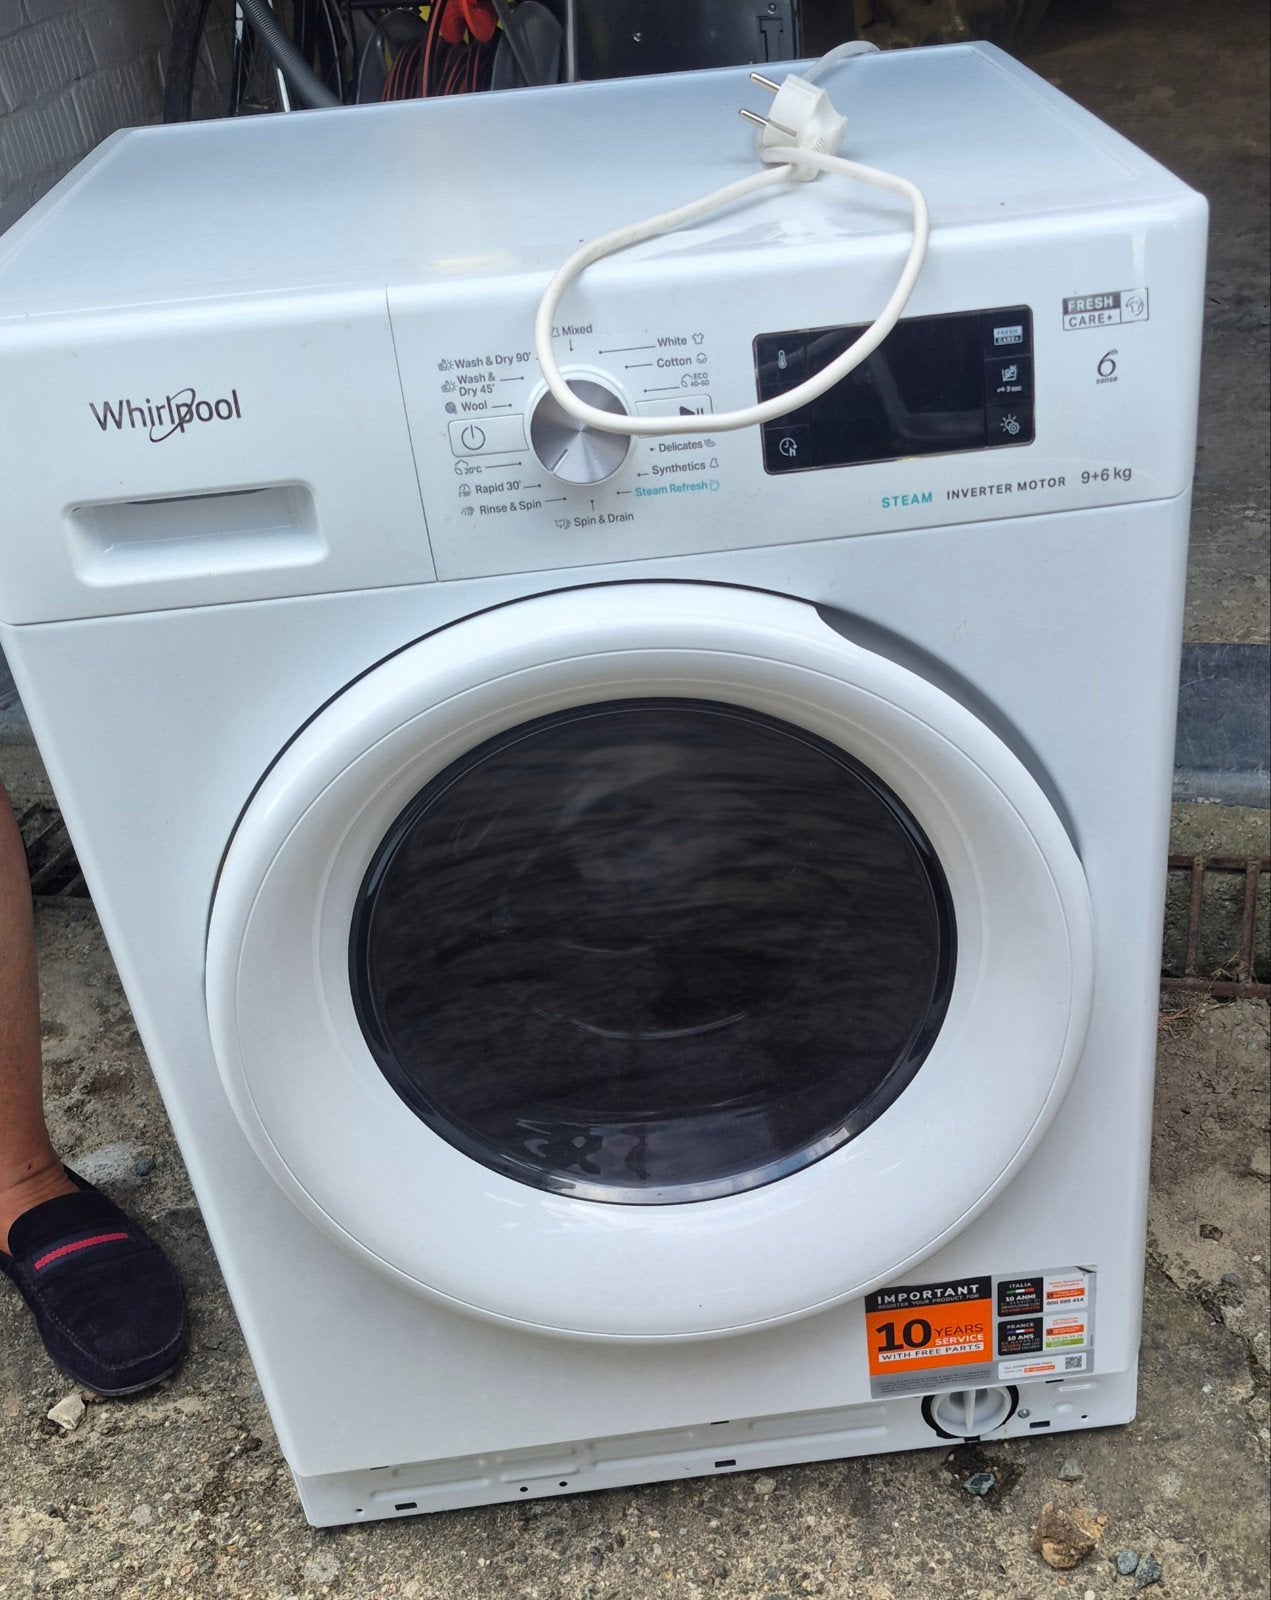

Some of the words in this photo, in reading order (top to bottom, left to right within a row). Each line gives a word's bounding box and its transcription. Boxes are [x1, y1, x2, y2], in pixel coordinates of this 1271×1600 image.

[1067, 295, 1113, 312] FRESH
[1068, 313, 1113, 328] CARE+
[562, 324, 593, 336] Mixed
[657, 336, 687, 347] White
[454, 357, 484, 369] Wash
[485, 356, 493, 366] &
[495, 354, 514, 366] Dry
[656, 357, 692, 368] Cotton
[457, 373, 486, 385] Wash
[488, 371, 495, 382] &
[693, 372, 709, 380] ECO
[459, 386, 478, 398] Dry
[461, 400, 488, 412] Wool
[89, 388, 242, 443] Whirlpool
[658, 440, 704, 453] Delicates
[652, 461, 706, 476] Synthetics
[475, 481, 504, 494] Rapid
[635, 486, 668, 497] Steam
[669, 480, 708, 493] Refresh
[881, 491, 933, 509] STEAM
[946, 483, 1013, 501] INVERTER
[1017, 476, 1066, 492] MOTOR
[1081, 469, 1110, 484] 9+6
[1114, 467, 1132, 481] kg
[479, 502, 508, 516] Rinse
[510, 503, 517, 512] &
[519, 500, 542, 513] Spin
[573, 514, 597, 528] Spin
[598, 515, 606, 524] &
[607, 512, 635, 523] Drain
[877, 1284, 979, 1304] IMPORTANT
[932, 1295, 963, 1303] PRODUCT
[1015, 1293, 1036, 1301] ANNI
[934, 1323, 984, 1337] YEARS
[1006, 1322, 1034, 1330] FRANCE
[875, 1318, 932, 1352] 10
[935, 1333, 984, 1346] SERVICE
[1017, 1333, 1034, 1341] ANS
[882, 1351, 911, 1361] WITH
[915, 1348, 941, 1357] FREE
[945, 1343, 981, 1353] PARTS
